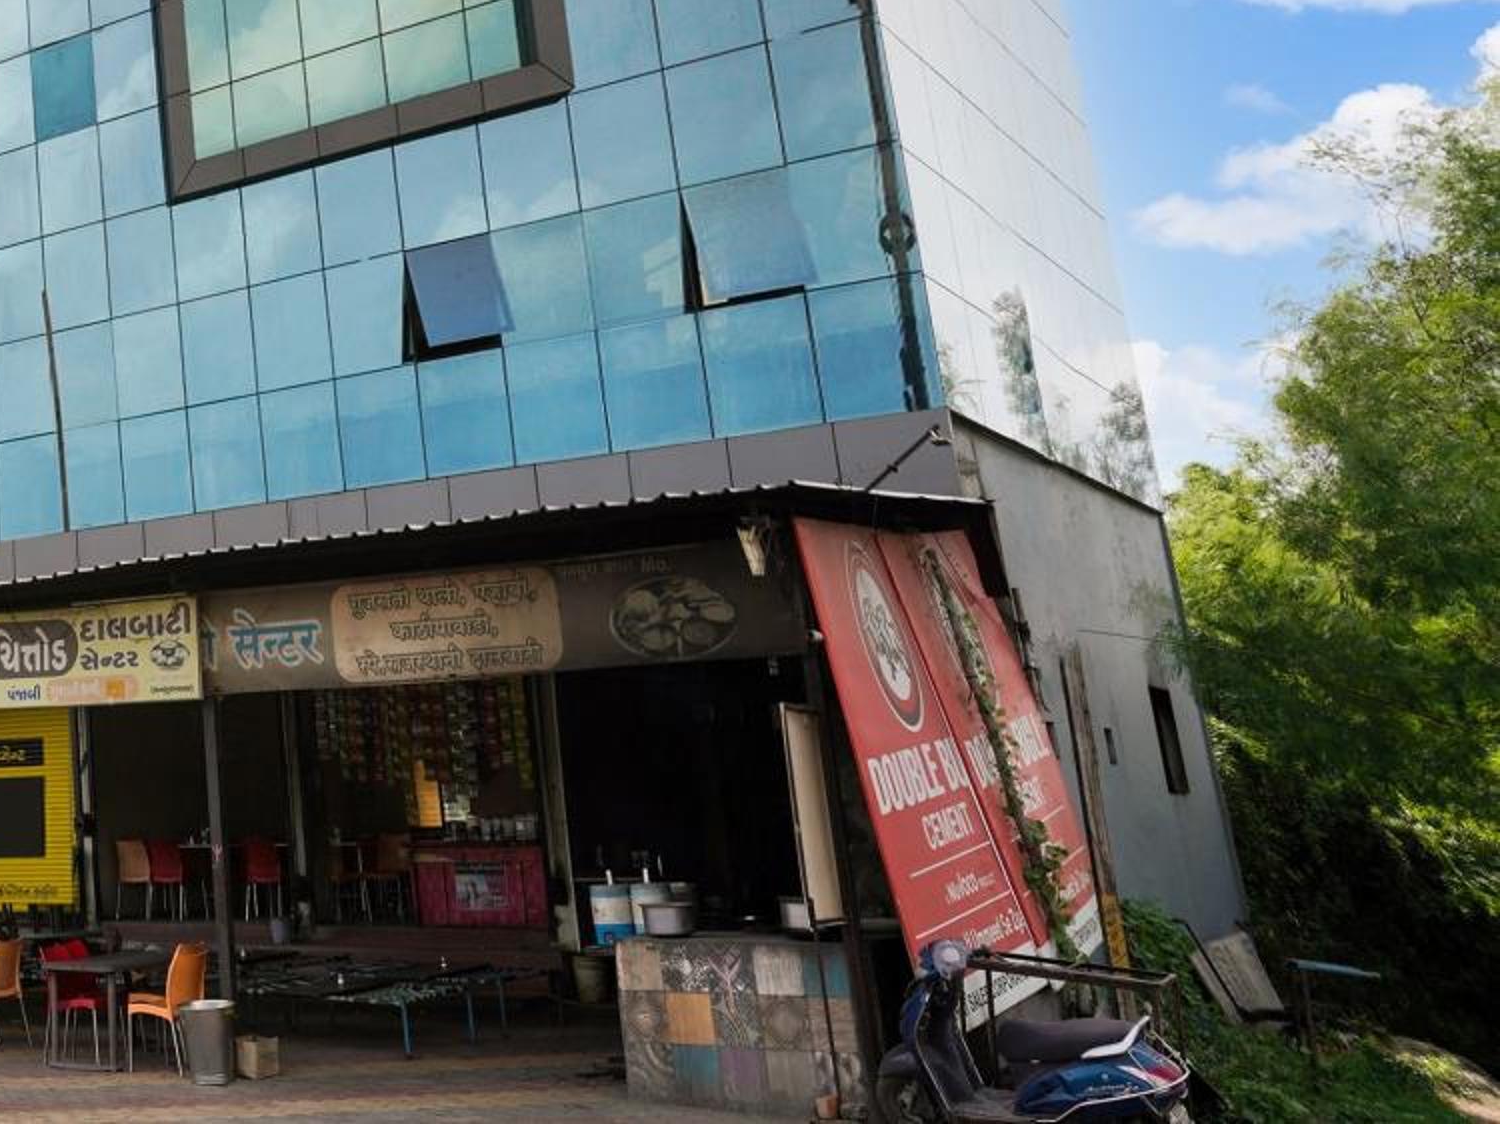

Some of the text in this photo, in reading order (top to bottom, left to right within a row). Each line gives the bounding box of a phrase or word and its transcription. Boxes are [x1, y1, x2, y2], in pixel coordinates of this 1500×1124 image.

[79, 601, 191, 642] દાલબાટી
[867, 743, 945, 816] DOUBLE
[921, 802, 974, 850] CEMENT
